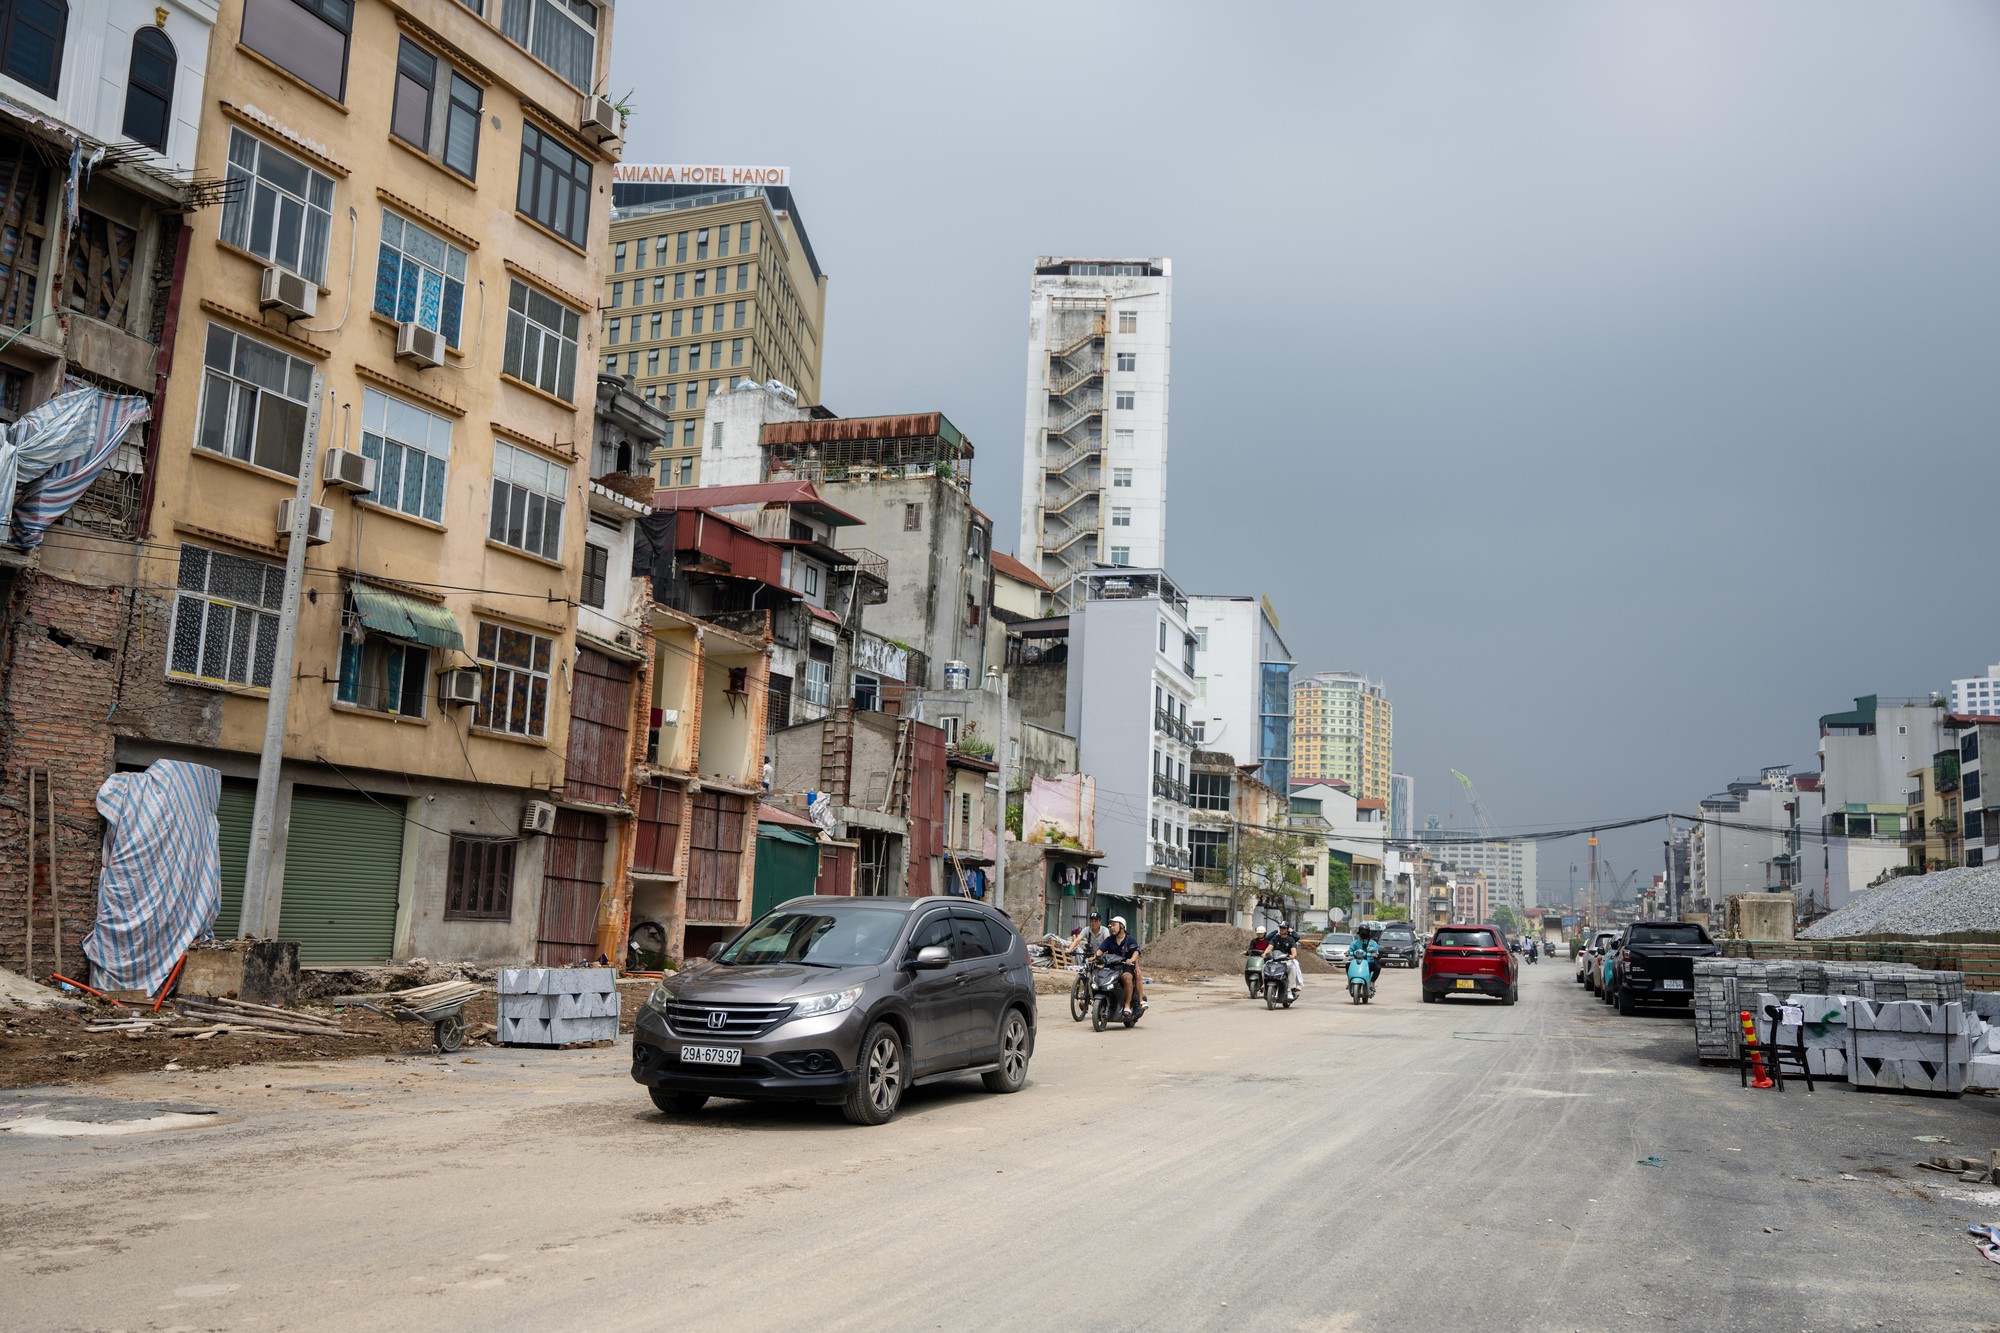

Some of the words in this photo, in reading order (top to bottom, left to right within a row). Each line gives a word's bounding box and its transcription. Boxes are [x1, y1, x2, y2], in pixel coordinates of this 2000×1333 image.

[680, 167, 726, 182] HOTEL
[732, 168, 784, 184] HANOI
[682, 1047, 740, 1063] 29A-679.97
